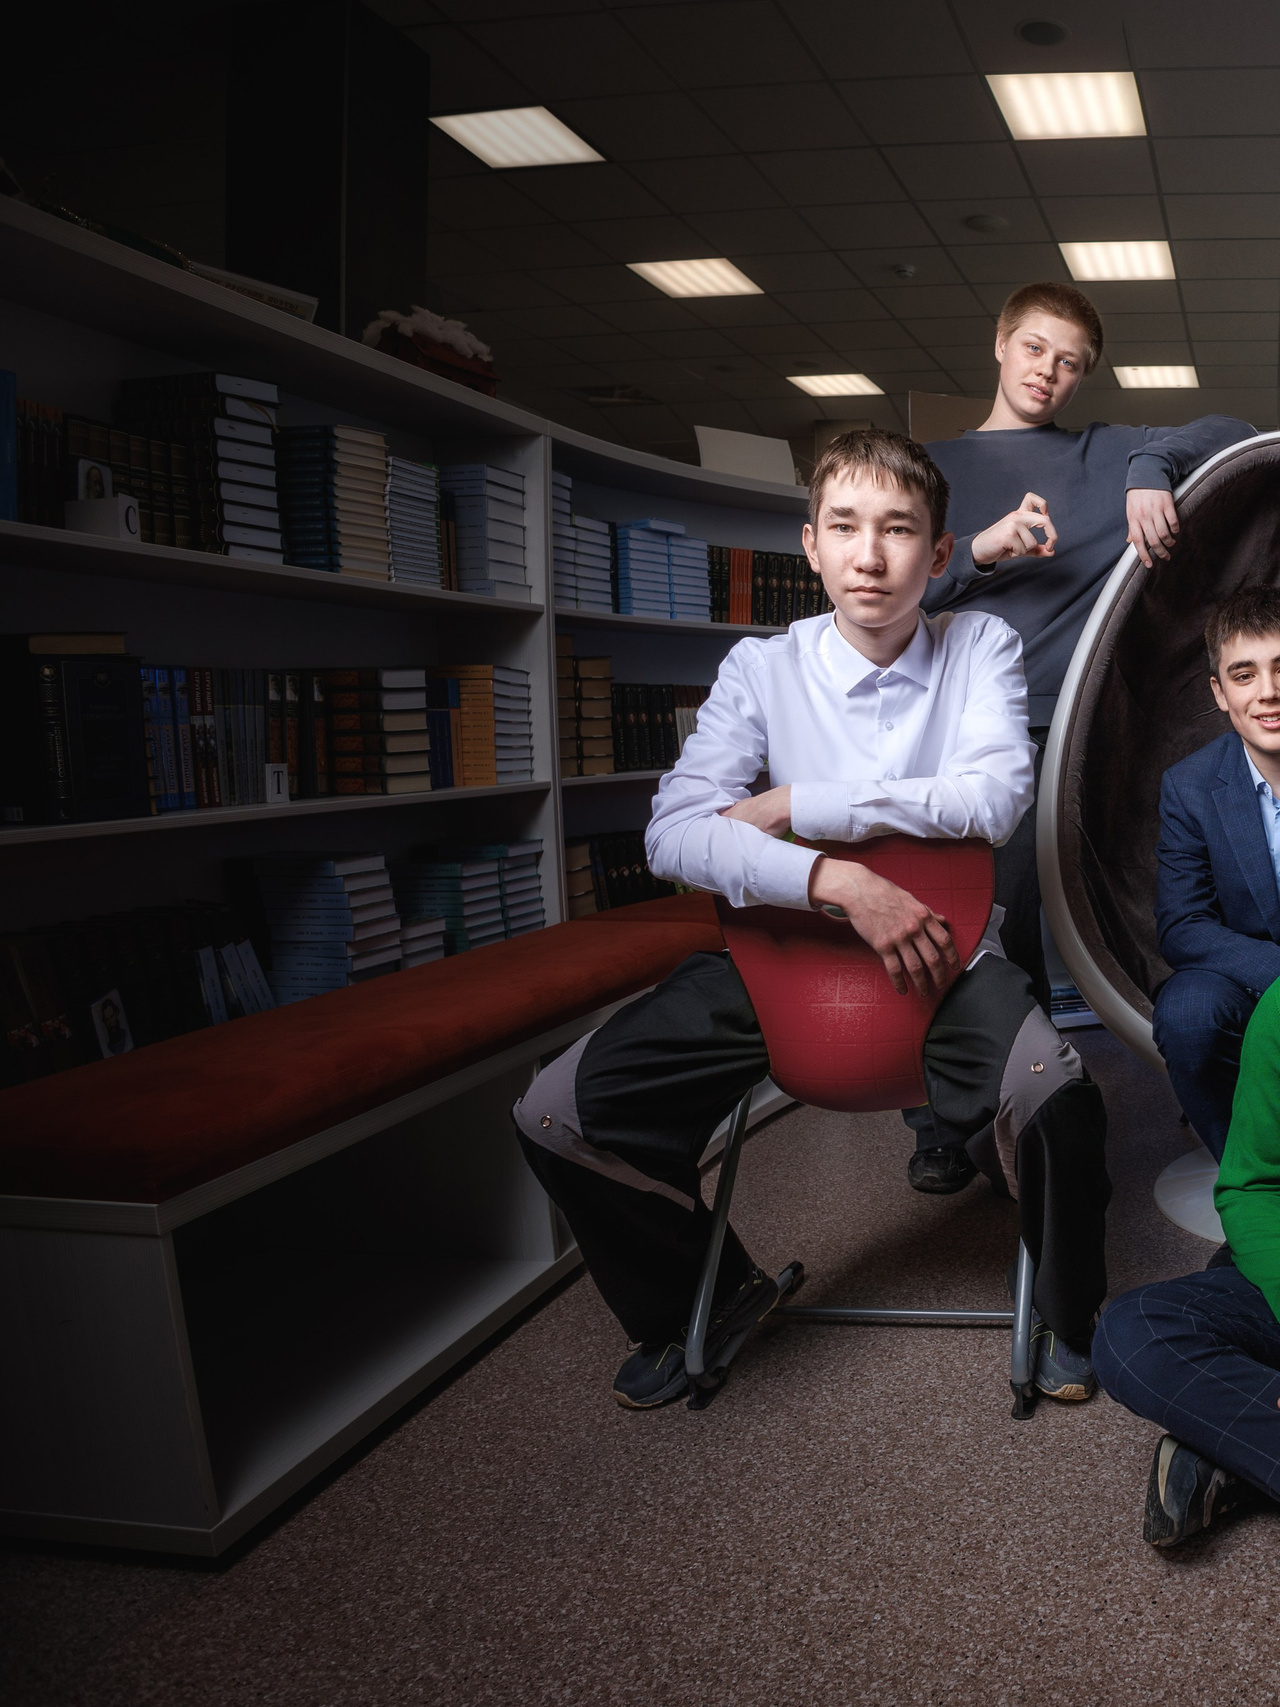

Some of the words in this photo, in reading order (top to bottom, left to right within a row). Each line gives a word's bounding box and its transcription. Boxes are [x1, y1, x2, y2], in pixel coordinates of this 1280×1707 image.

[125, 505, 137, 534] С
[194, 671, 202, 712] СТРУГАЦКИЕ
[273, 770, 284, 795] Т
